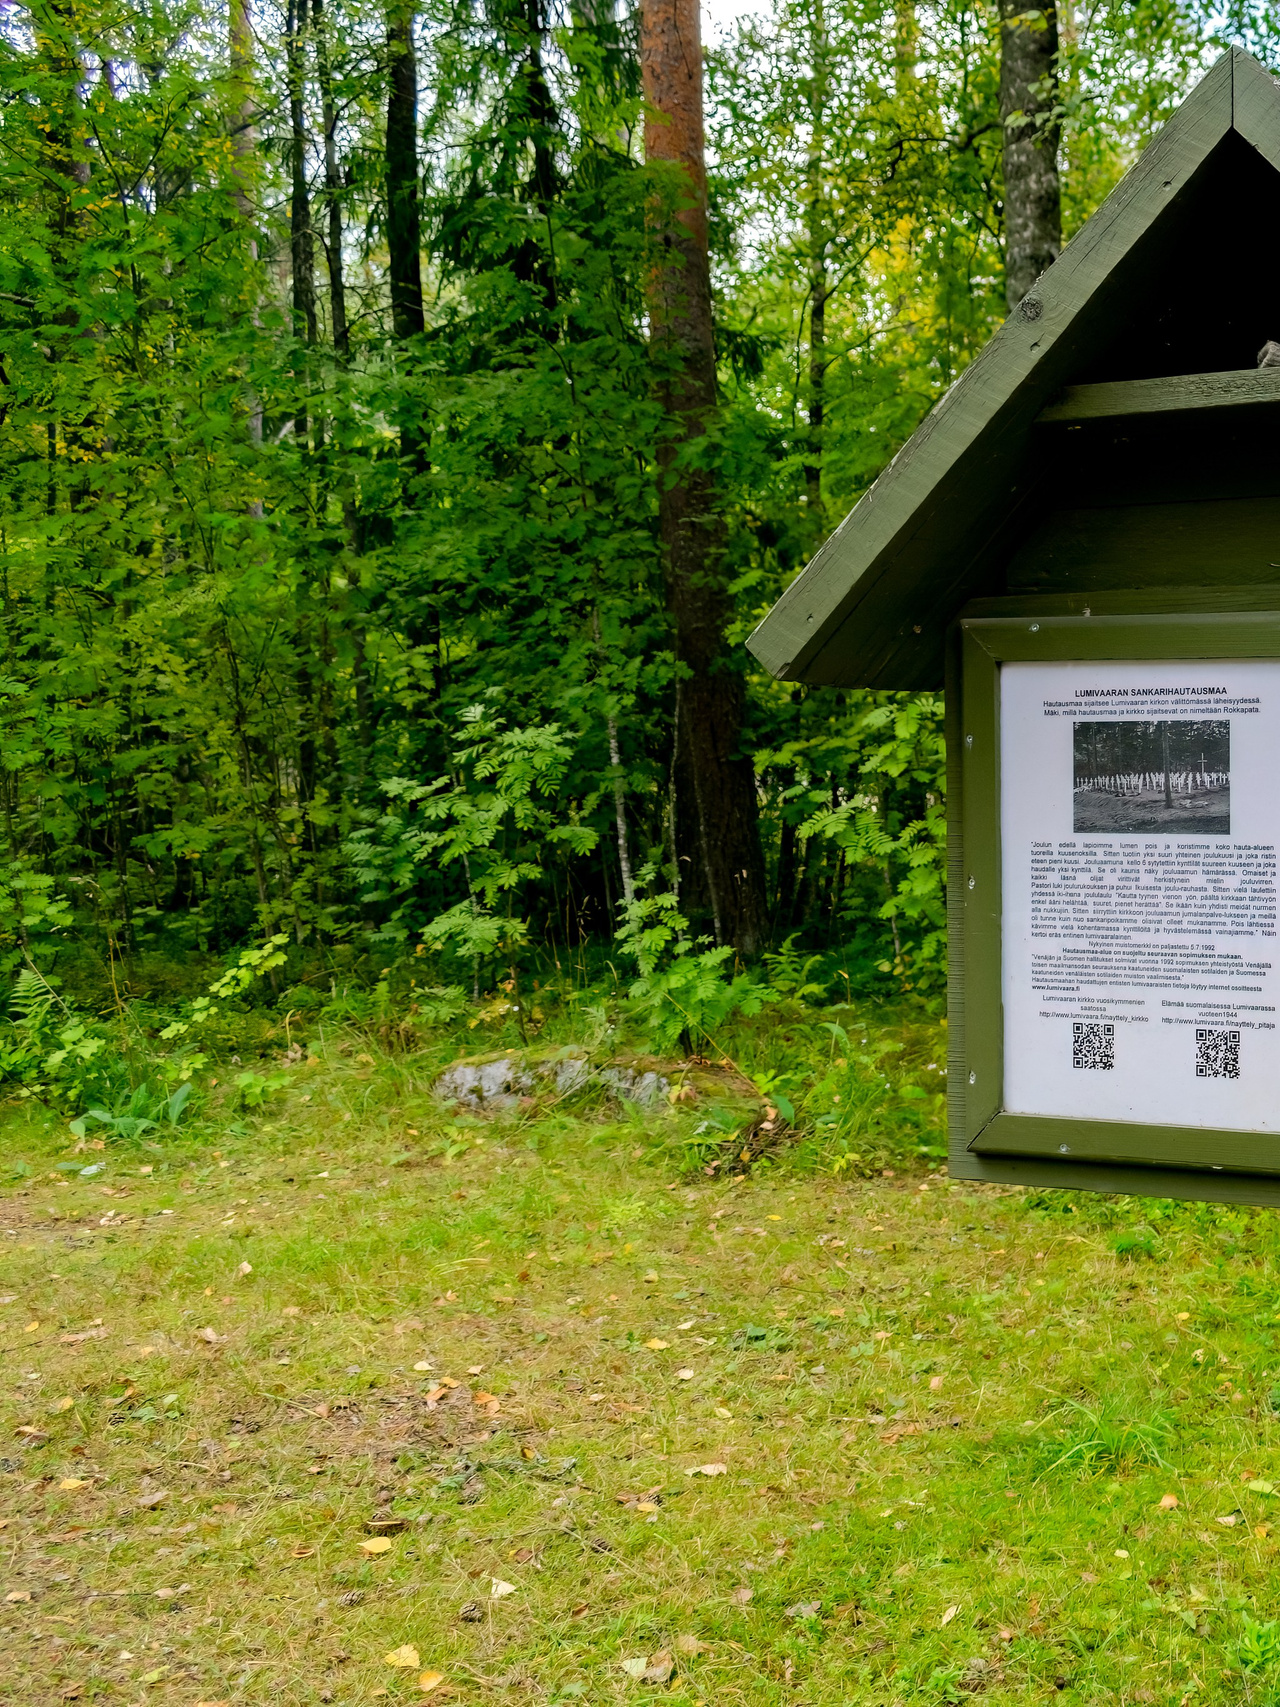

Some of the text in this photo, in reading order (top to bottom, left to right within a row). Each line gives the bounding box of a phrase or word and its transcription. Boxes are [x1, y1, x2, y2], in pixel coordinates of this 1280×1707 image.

[1075, 687, 1227, 697] LUMIVAARAN SANKARIHAUTAUSMAA
[1084, 699, 1109, 708] sijaitsee
[1147, 707, 1178, 716] sijaitsevat
[1083, 841, 1113, 850] lapioimme
[1145, 842, 1157, 851] pois
[1154, 876, 1190, 885] herkistynein
[1089, 940, 1113, 949] Nykyinen
[1115, 941, 1151, 949] muistomerkki
[1161, 942, 1189, 951] paljastettu
[1122, 949, 1146, 958] suojeltu
[1179, 951, 1216, 960] sopimuksen
[1217, 952, 1243, 960] mukaan.
[1086, 955, 1113, 963] hallitukset
[1115, 956, 1137, 964] solmivat
[1176, 959, 1209, 967] sopimuksen
[1032, 975, 1075, 984] Hautausmaahan
[1076, 977, 1108, 987] haudattujen
[1173, 981, 1189, 991] tietoja
[1231, 984, 1262, 992] osoitteesta
[1043, 994, 1076, 1002] Lumivaaran
[1096, 997, 1145, 1006] vuosikymmenien
[1186, 1001, 1231, 1009] suomalaisessa
[1233, 1003, 1276, 1012] Lumivaarassa
